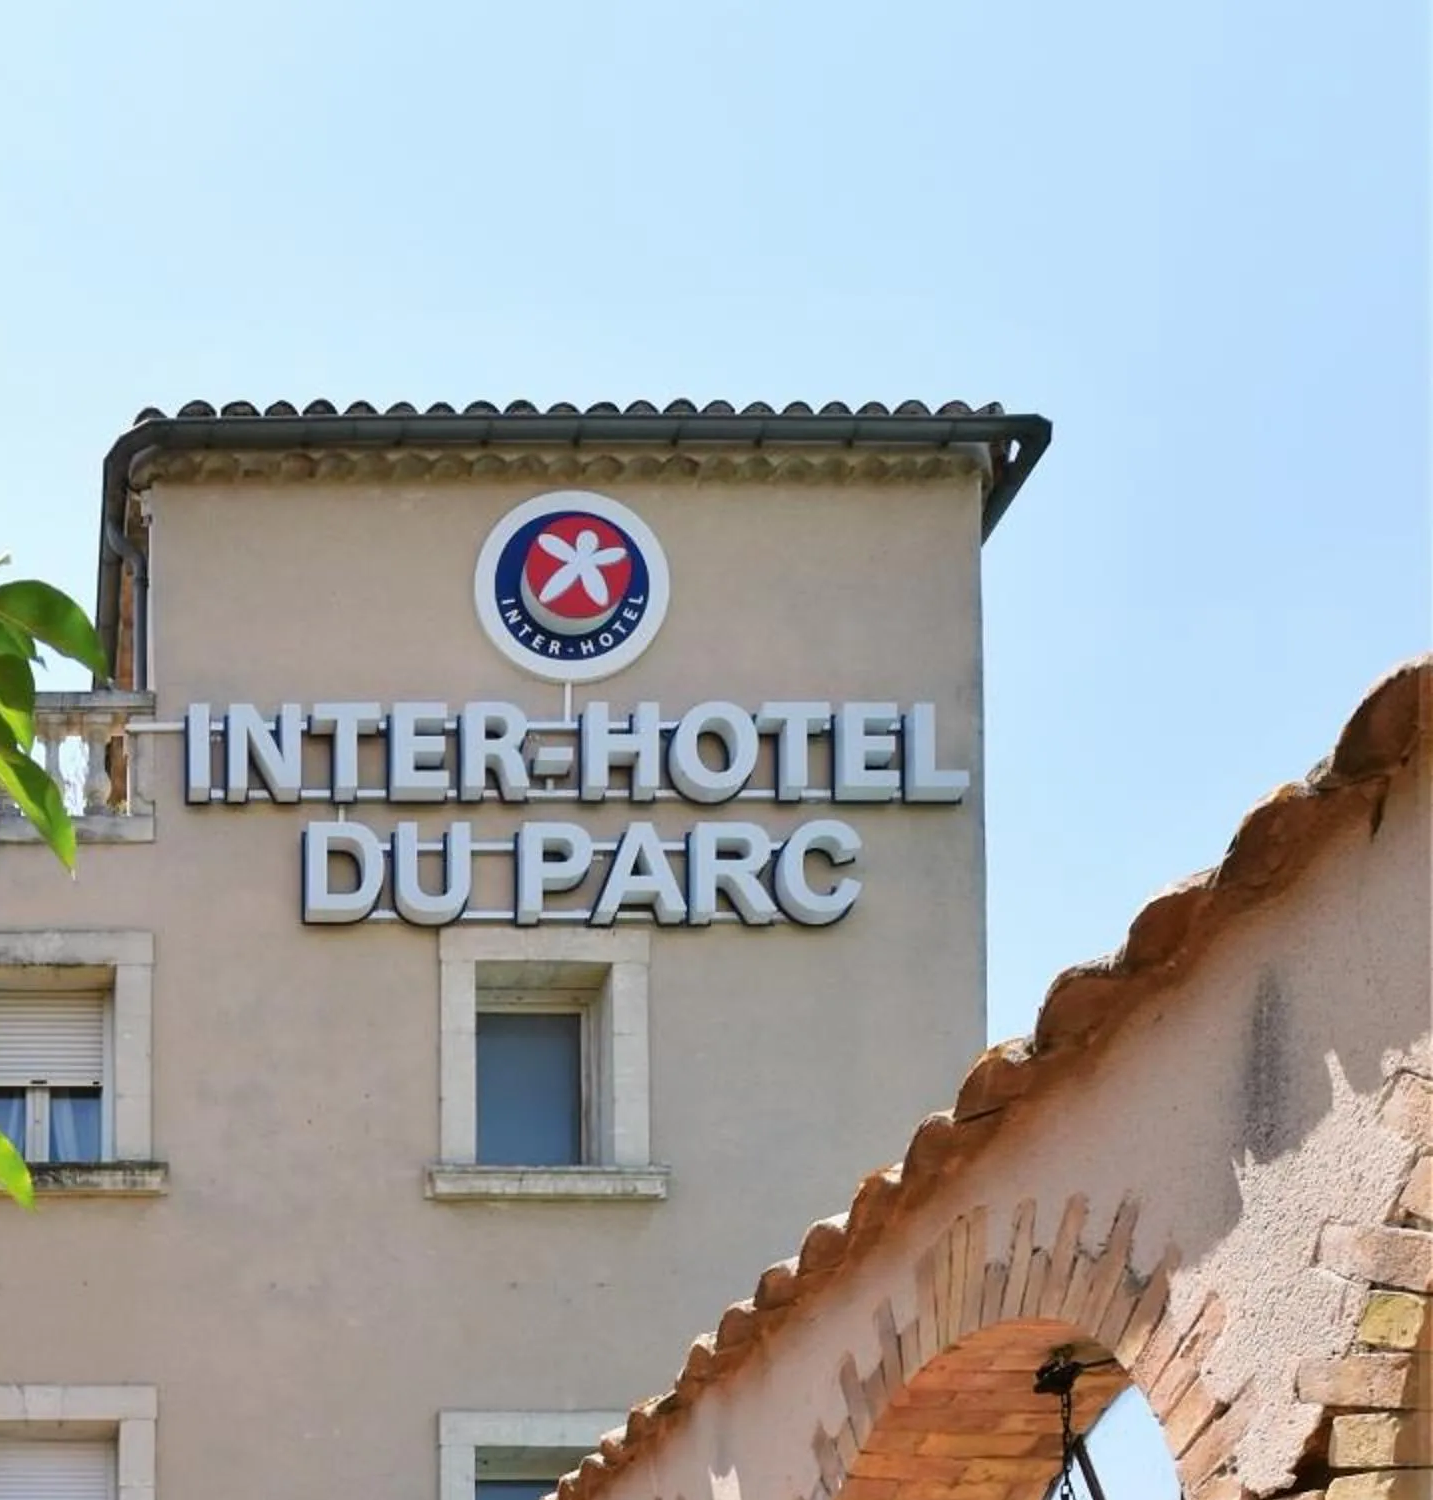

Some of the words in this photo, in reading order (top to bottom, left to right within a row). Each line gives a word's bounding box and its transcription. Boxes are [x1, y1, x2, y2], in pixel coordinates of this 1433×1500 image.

[502, 594, 644, 655] INTER-HOTEL
[185, 701, 969, 804] INTER-HOTEL
[301, 820, 472, 926] DU
[515, 819, 863, 926] PARC
